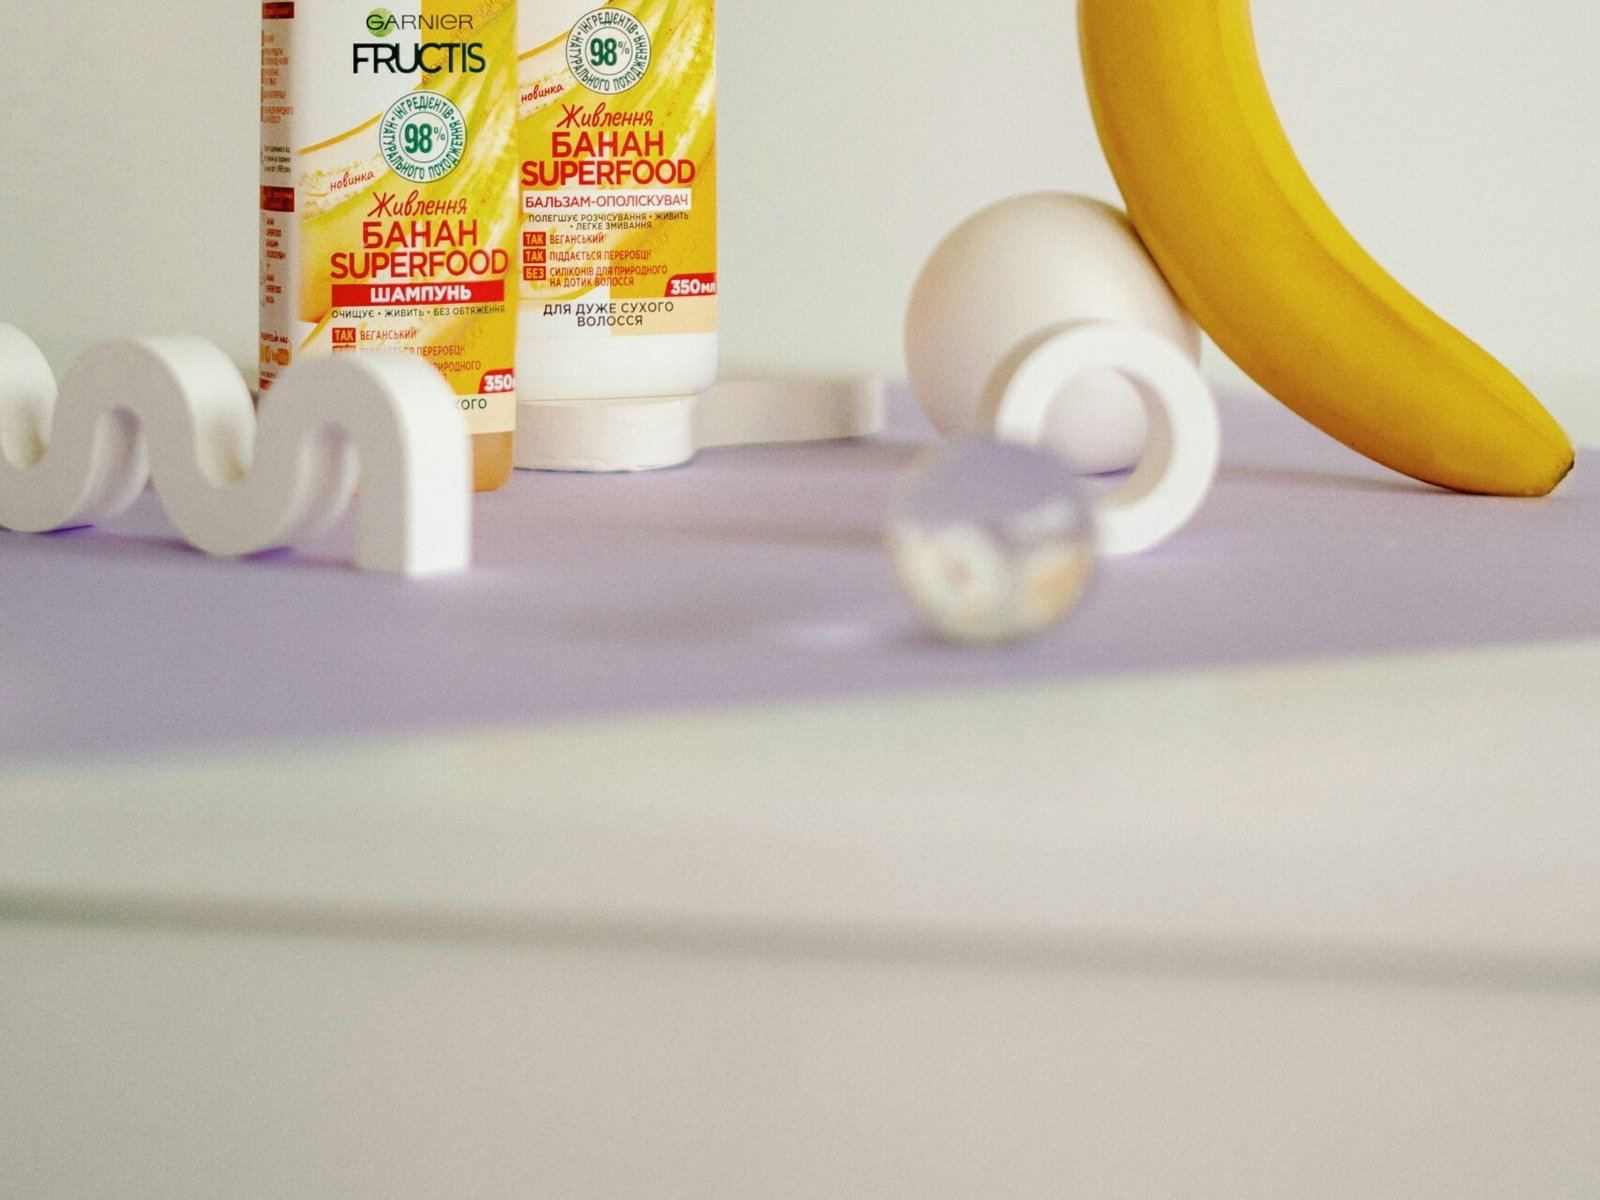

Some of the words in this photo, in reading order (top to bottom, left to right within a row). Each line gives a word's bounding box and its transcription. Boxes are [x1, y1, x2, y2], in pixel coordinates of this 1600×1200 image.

[366, 14, 473, 31] GARNIER
[578, 11, 637, 35] ІНГРЕДІЄНТІВ
[353, 43, 486, 74] FRUCTIS
[569, 35, 610, 91] НАТУРАЛЬНОГО
[613, 35, 648, 90] ПОХОДЖЕННЯ
[590, 38, 630, 67] 98%
[521, 82, 565, 104] новинка
[393, 95, 454, 121] ІНГРЕДІЄНТІВ
[556, 102, 654, 128] Живлення
[404, 123, 446, 154] 98%
[552, 131, 664, 157] БАНАН
[383, 120, 425, 180] НАТУРАЛЬНОГО
[428, 120, 464, 179] ПОХОДЖЕННЯ
[330, 169, 375, 192] новинка
[521, 159, 697, 187] SUPERFOOD
[367, 189, 468, 218] Живлення
[525, 194, 688, 208] БАЛЬЗАМ-ОПОЛІСКУВАЧ
[528, 213, 579, 223] ПОЛЕГШУЄ
[580, 213, 647, 222] РОЗЧІСУВАННЯ
[655, 212, 689, 220] ЖИВИТЬ
[576, 222, 604, 230] ЛЕГКЕ
[605, 222, 652, 230] ЗМИВАННЯ
[362, 219, 478, 249] БАНАН
[525, 234, 544, 245] ТАК
[330, 248, 510, 280] SUPERFOOD
[525, 252, 544, 262] ТАК
[550, 251, 602, 263] ПІДДАЄТЬСЯ
[526, 268, 545, 279] БЕЗ
[550, 266, 594, 277] СИЛІКОНІВ
[595, 266, 614, 276] ДЛЯ
[614, 265, 668, 276] ПРИРОДНОГО
[550, 278, 562, 287] НА
[563, 278, 593, 288] ДОТИК
[594, 278, 635, 287] ВОЛОССЯ
[370, 285, 472, 304] ШАМПУНЬ
[332, 310, 375, 319] ОЧИЩУЄ
[384, 309, 425, 318] ЖИВИТЬ
[434, 308, 450, 316] БЕЗ
[453, 305, 505, 315] ОБТЯЖЕННЯ
[543, 304, 572, 317] ДЛЯ
[575, 303, 616, 316] ДУЖЕ
[620, 301, 674, 313] СУХОГО
[577, 316, 643, 328] ВОЛОССЯ
[334, 329, 355, 341] ТАК
